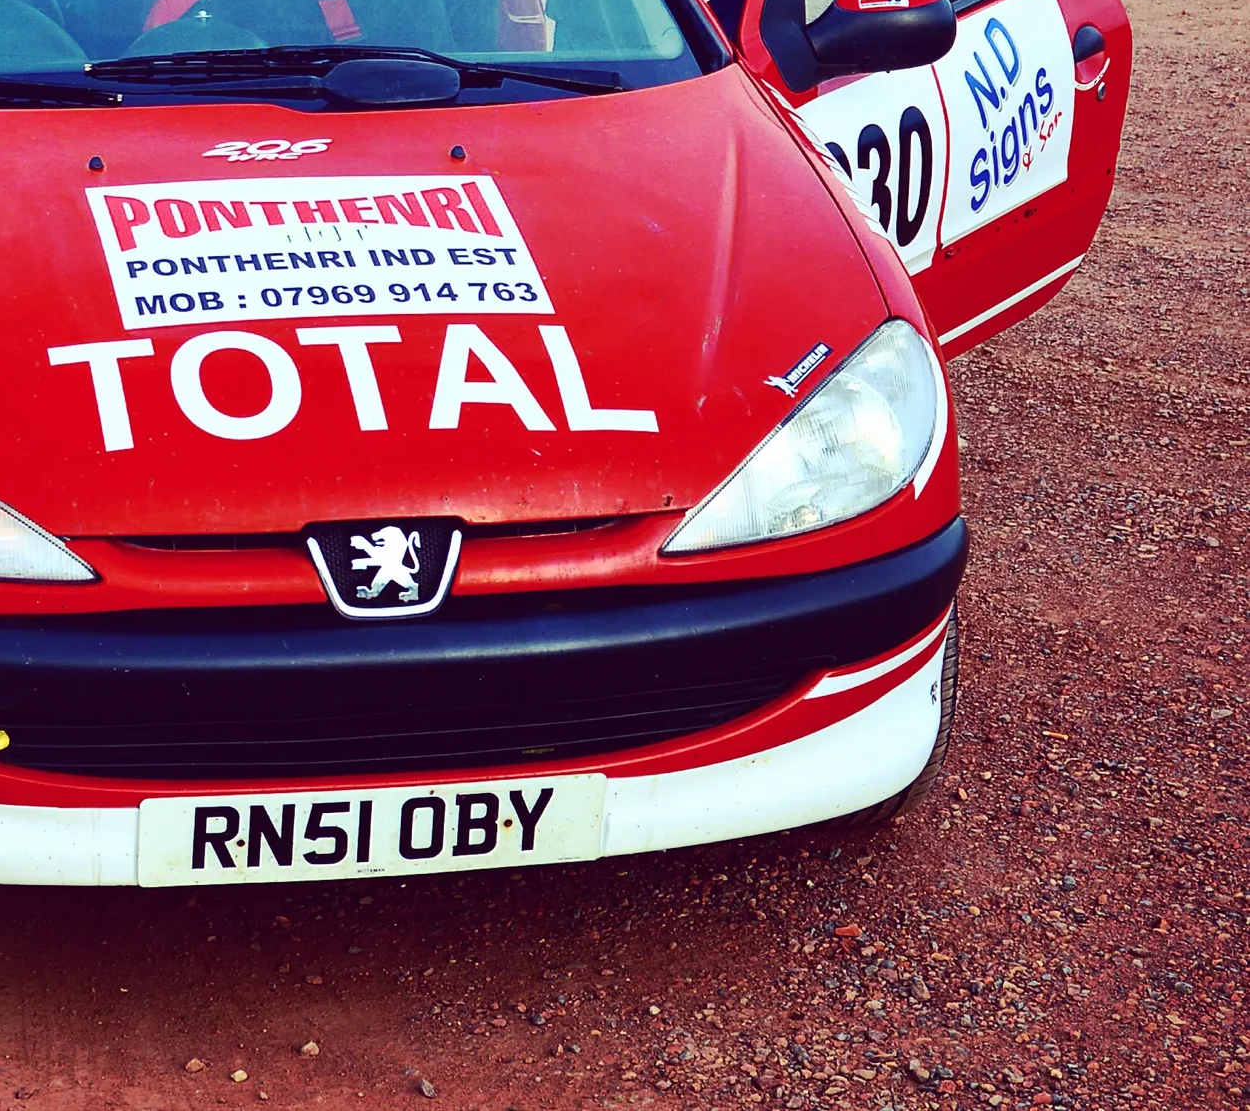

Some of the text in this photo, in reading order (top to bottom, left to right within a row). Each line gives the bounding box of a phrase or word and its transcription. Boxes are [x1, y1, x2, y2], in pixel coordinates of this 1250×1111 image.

[202, 139, 333, 157] 206
[227, 151, 303, 163] WRC
[970, 67, 1054, 213] Signs
[104, 180, 504, 252] PONTHENRI
[126, 247, 518, 279] PONTHENRI IND EST
[134, 290, 225, 316] MOB
[260, 284, 377, 308] 07969
[389, 283, 458, 303] 914
[475, 282, 539, 303] 763
[786, 343, 829, 384] MICHELIN
[47, 323, 660, 453] TOTAL
[191, 786, 555, 871] RN51 OBY
